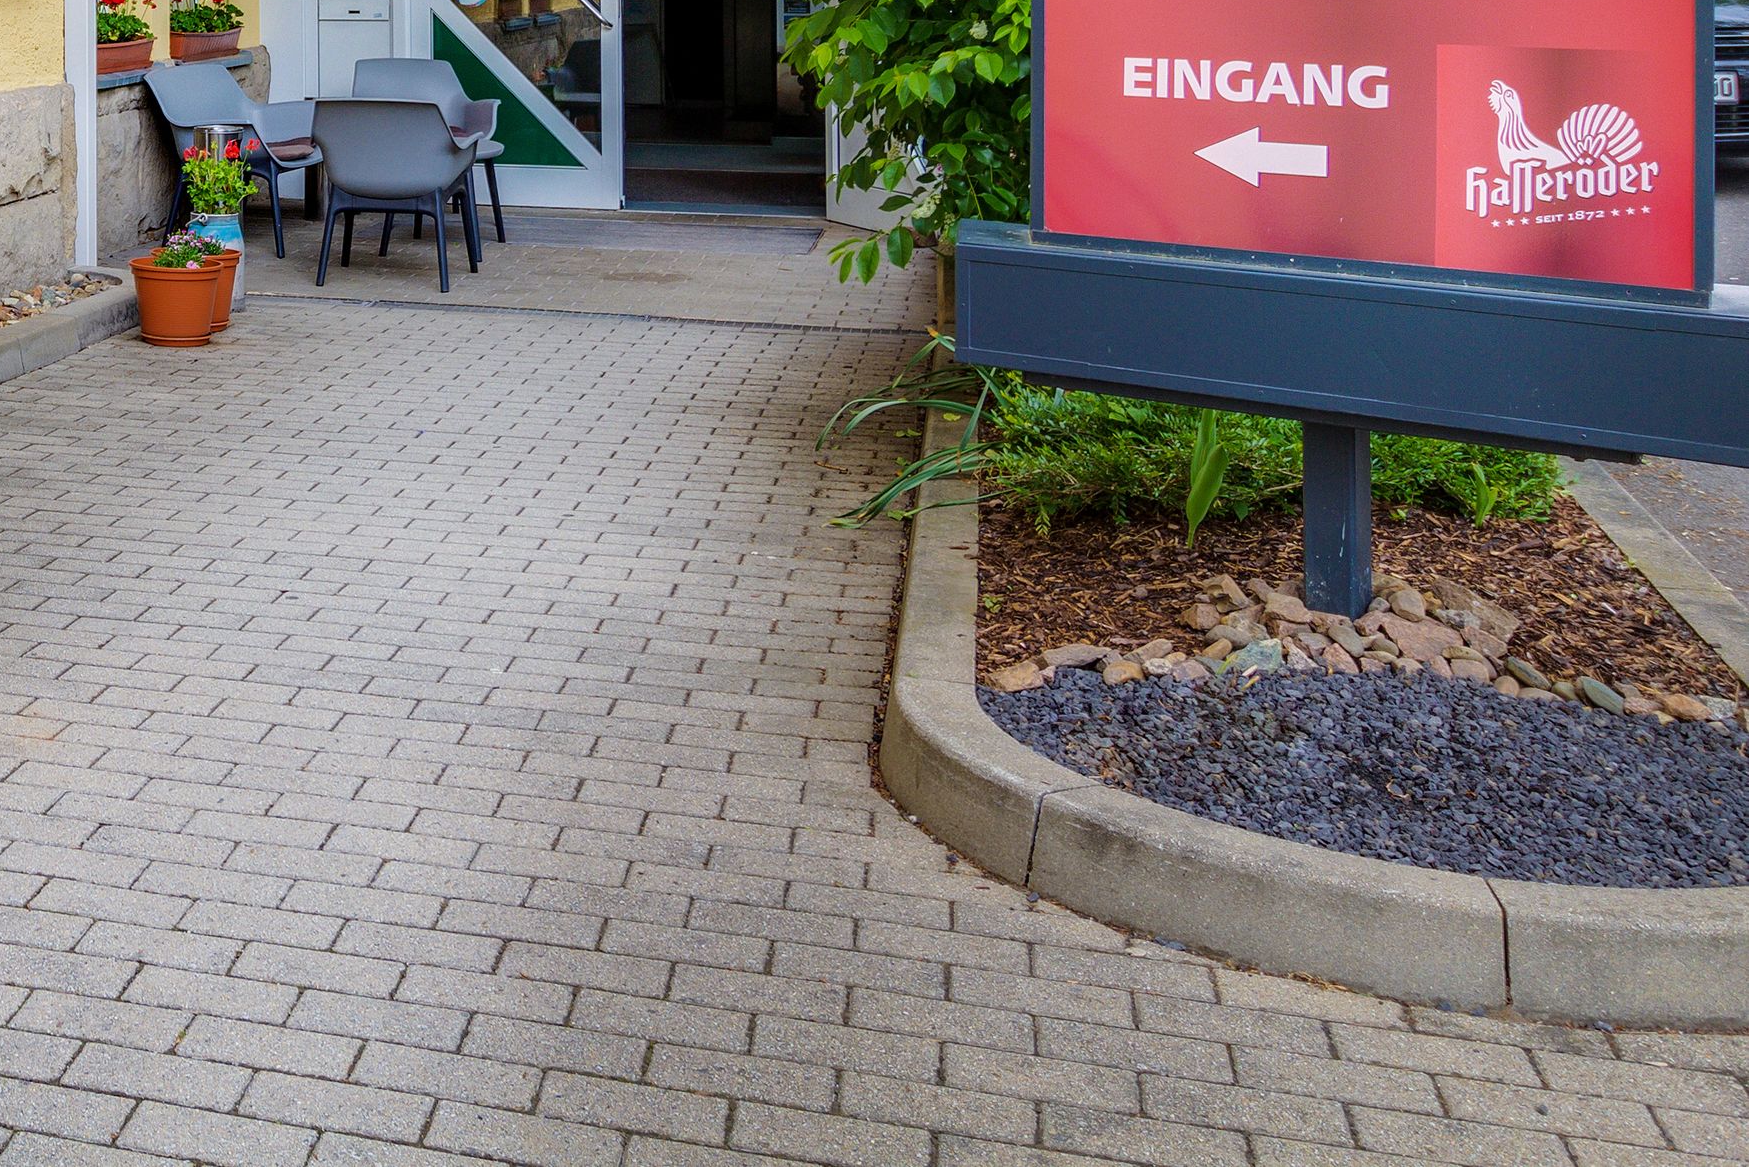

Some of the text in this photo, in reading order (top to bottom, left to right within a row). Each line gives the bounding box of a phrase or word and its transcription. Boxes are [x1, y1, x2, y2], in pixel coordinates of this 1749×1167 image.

[1123, 56, 1390, 110] EINGANG
[1535, 210, 1606, 225] SEIT 1872
